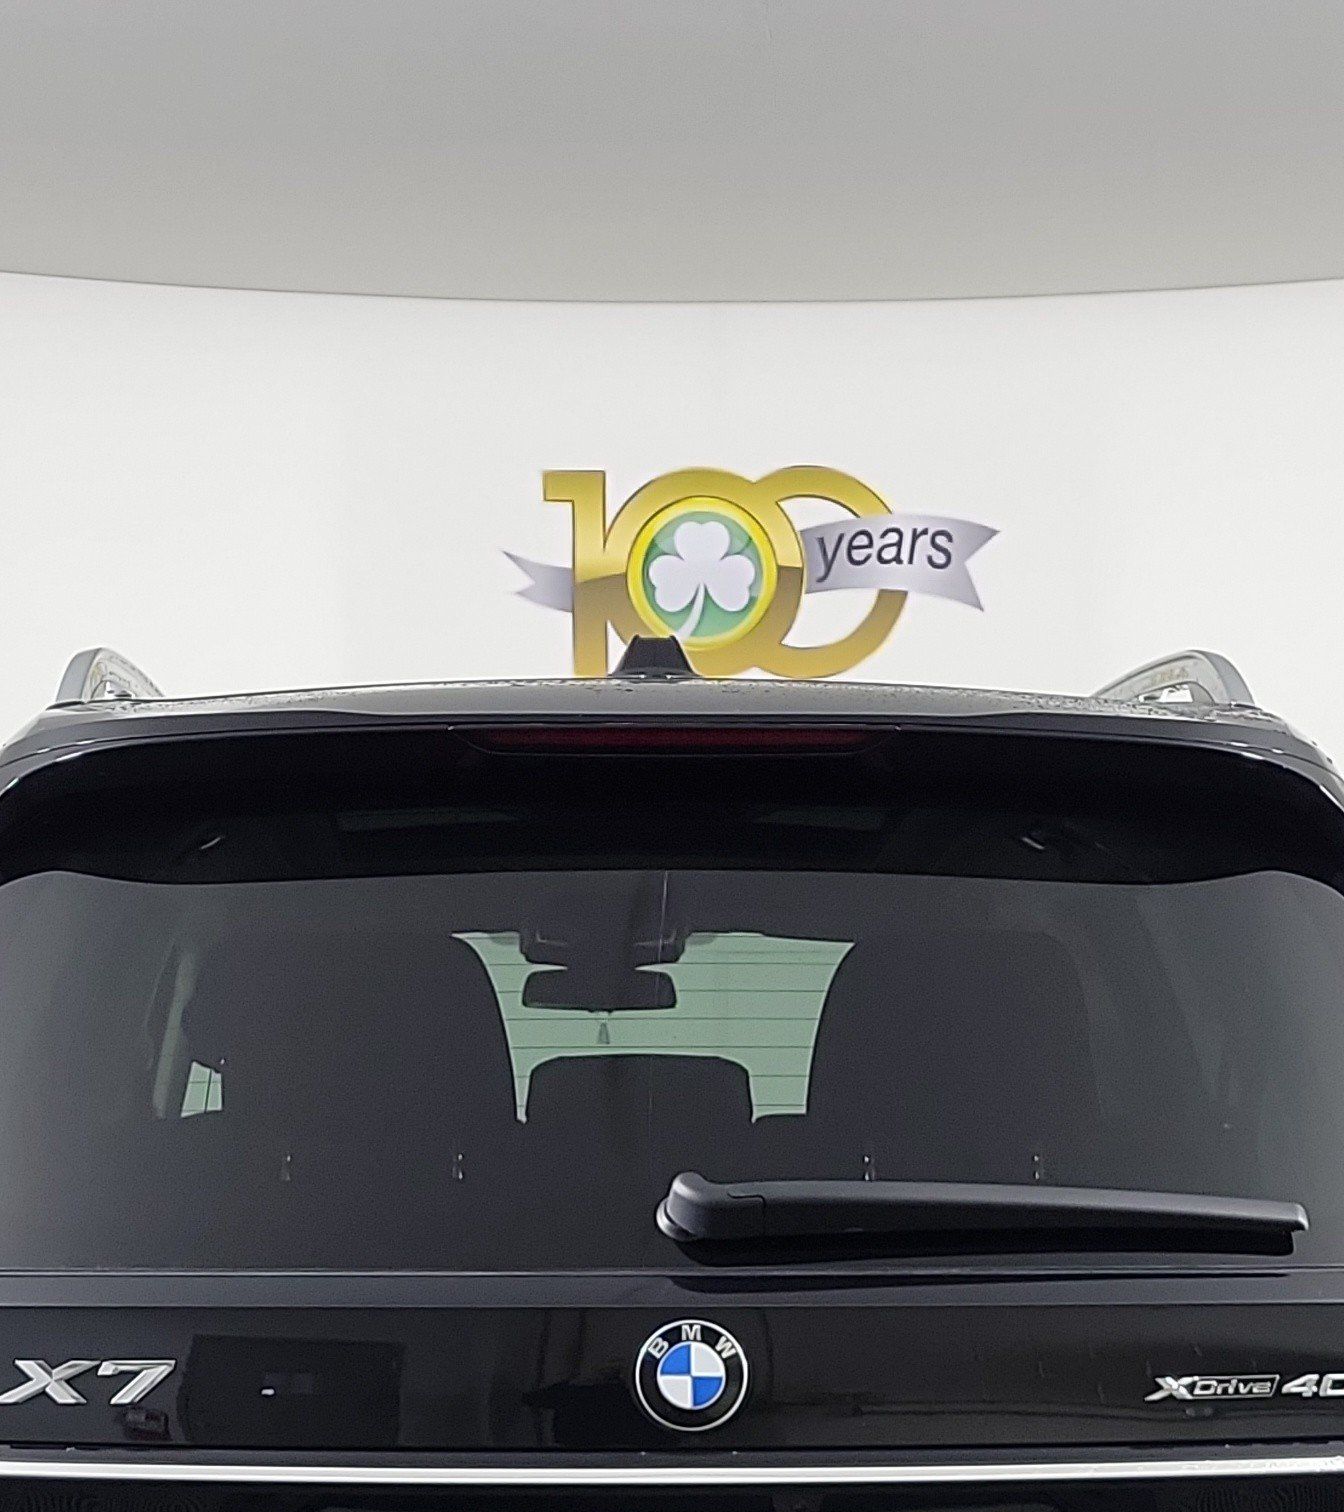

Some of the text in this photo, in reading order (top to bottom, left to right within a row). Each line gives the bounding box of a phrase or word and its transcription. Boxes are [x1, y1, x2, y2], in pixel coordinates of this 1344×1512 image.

[542, 465, 908, 679] 100
[814, 526, 954, 583] years
[647, 1323, 737, 1360] BMW
